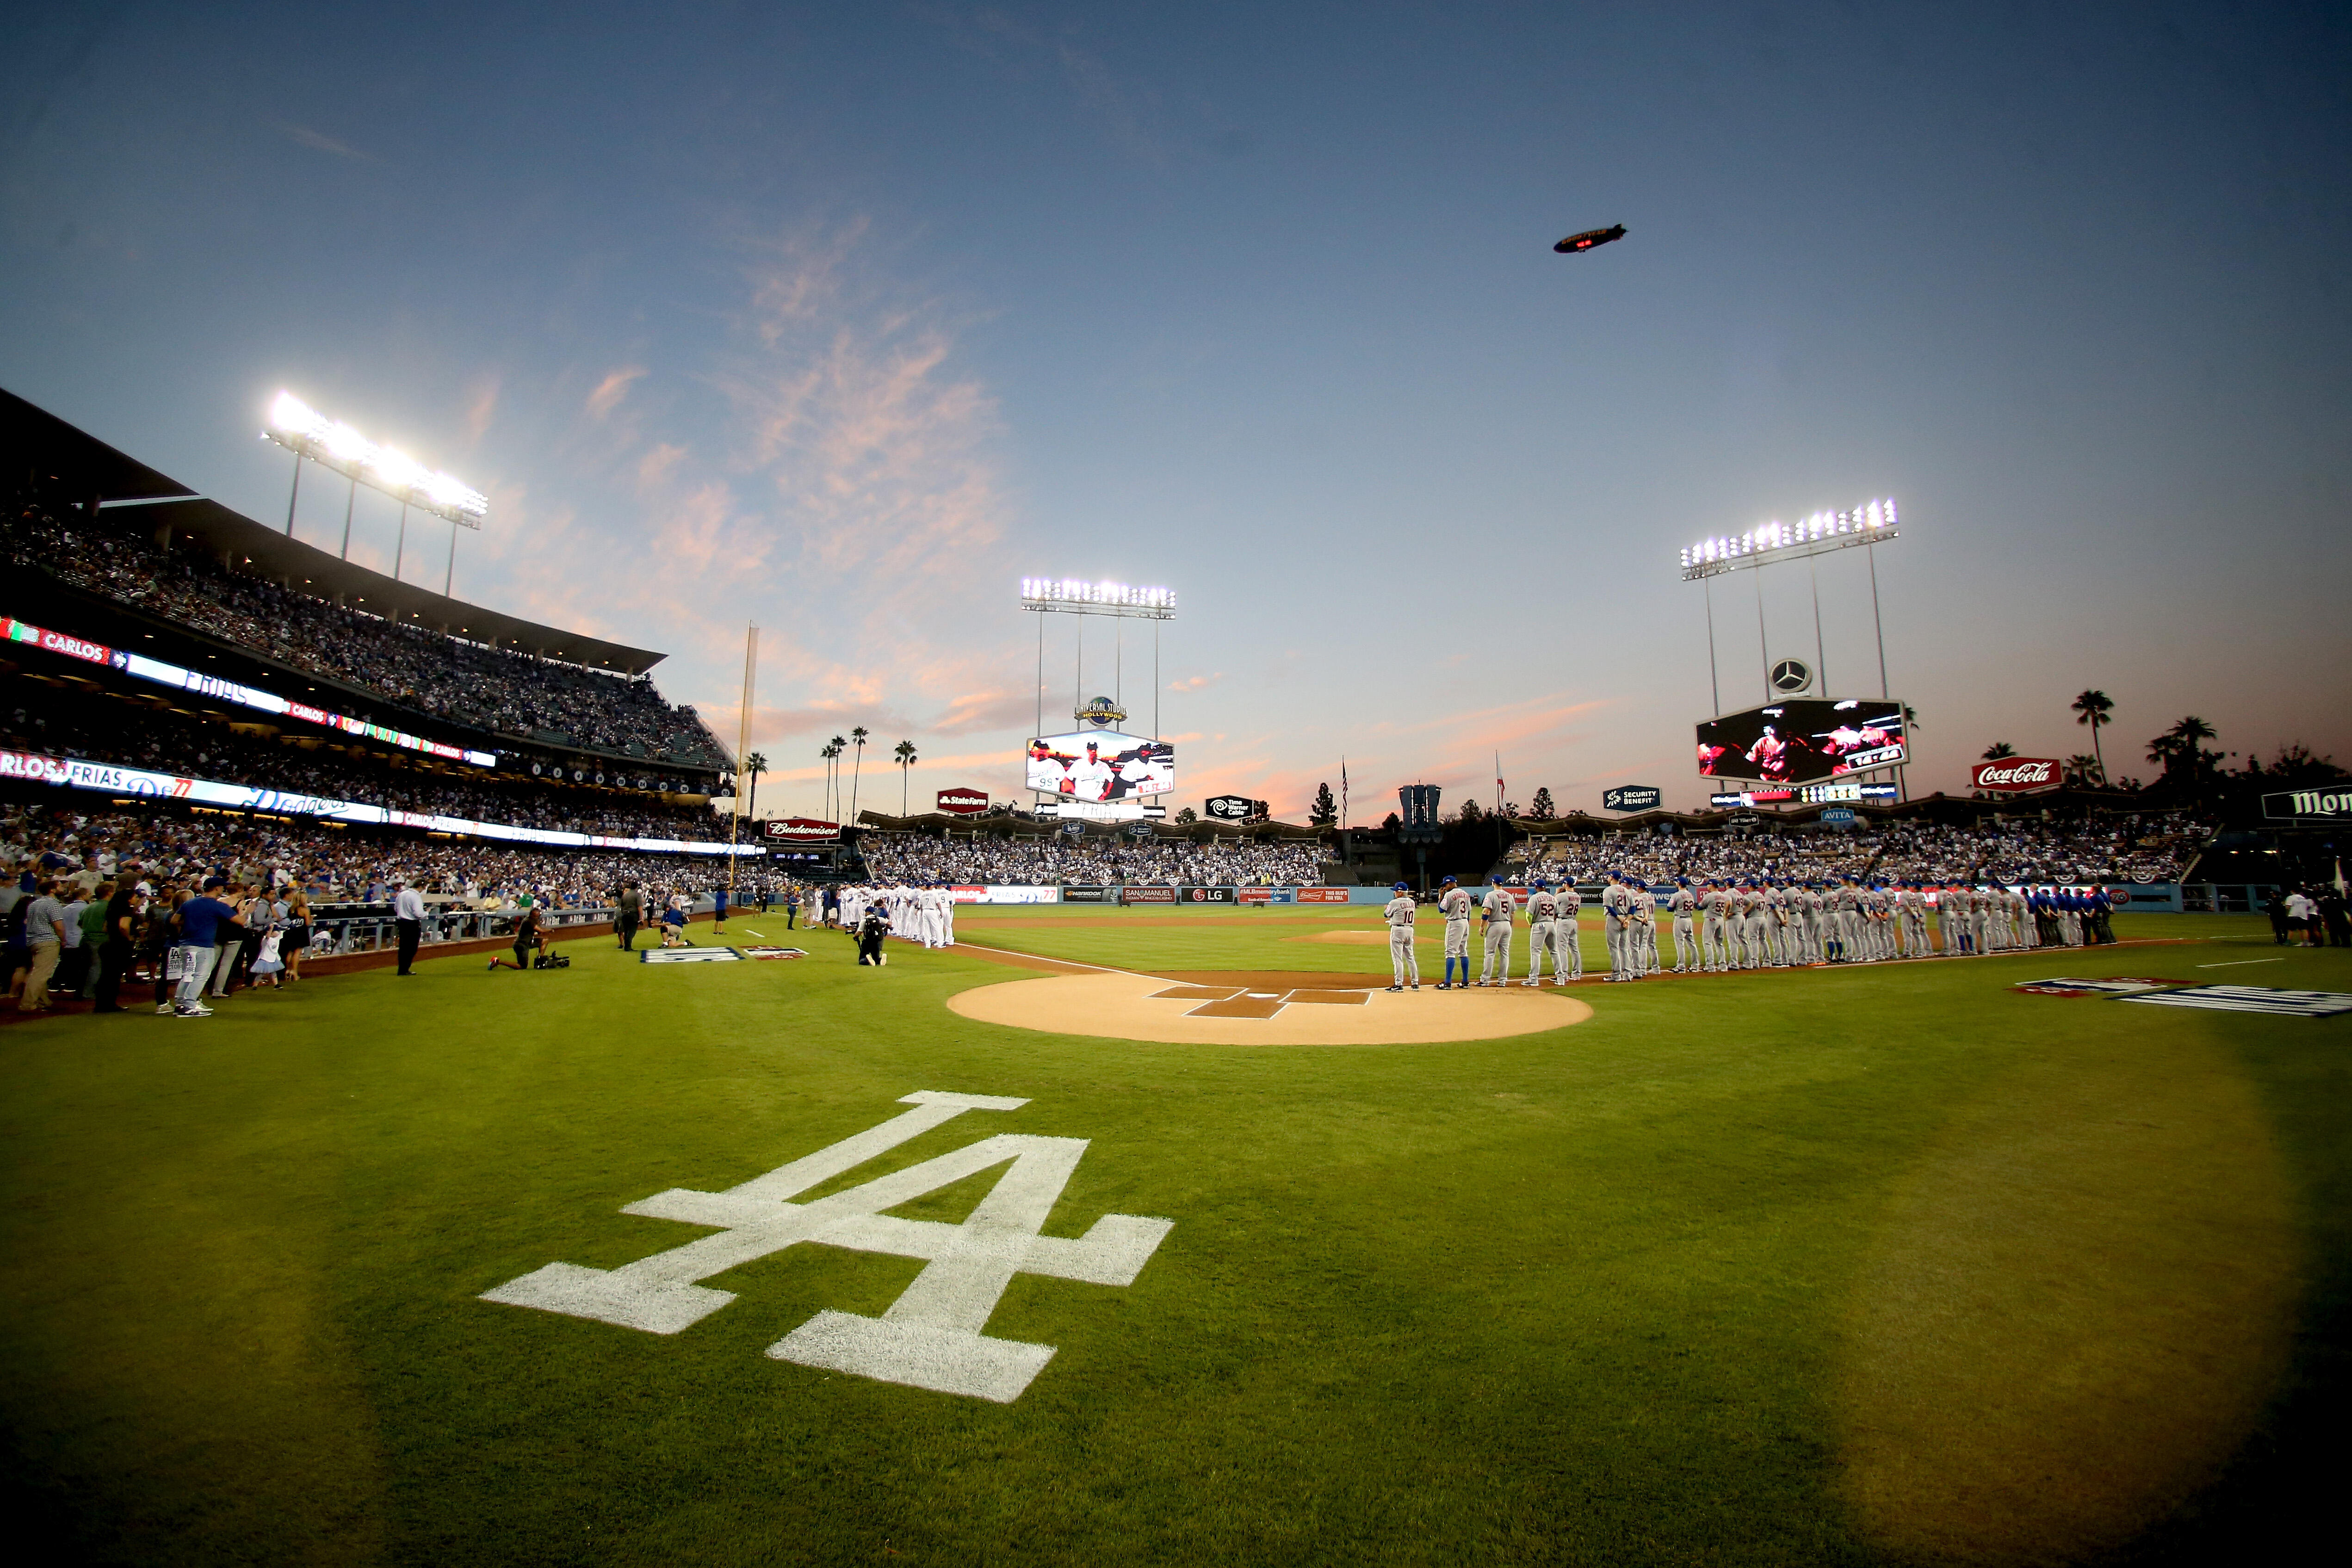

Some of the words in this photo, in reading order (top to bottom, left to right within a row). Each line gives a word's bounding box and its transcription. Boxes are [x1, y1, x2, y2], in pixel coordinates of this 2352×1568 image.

[45, 633, 103, 660] CARLOS
[292, 705, 324, 723] CARLOS
[1076, 703, 1106, 713] UNIVERSAL
[1108, 703, 1128, 716] STUDIOS
[435, 744, 460, 758] CARLOS
[1978, 761, 2053, 785] Coca-Cola
[72, 765, 123, 787] FRIAS
[173, 778, 193, 796] 77
[1040, 778, 1052, 787] 99
[243, 787, 349, 816] Dodgers
[405, 813, 433, 828] CARLOS
[1824, 810, 1851, 820] AVITA
[769, 822, 838, 835] Budweiser
[606, 837, 634, 848] CARLOS
[952, 890, 981, 899] ARLOS
[1043, 890, 1056, 899] 77
[1207, 890, 1222, 900] LG
[1616, 894, 1627, 907] 21
[2110, 892, 2127, 902] 76
[1460, 900, 1466, 913] 3
[1501, 901, 1509, 914] 5
[1541, 904, 1554, 916] 52
[1566, 904, 1578, 916] 28
[1648, 903, 1653, 914] 11
[1683, 900, 1694, 911] 62
[1758, 901, 1765, 911] 47
[1403, 910, 1414, 924] 10
[170, 948, 181, 959] LA
[477, 1090, 1175, 1404] LA
